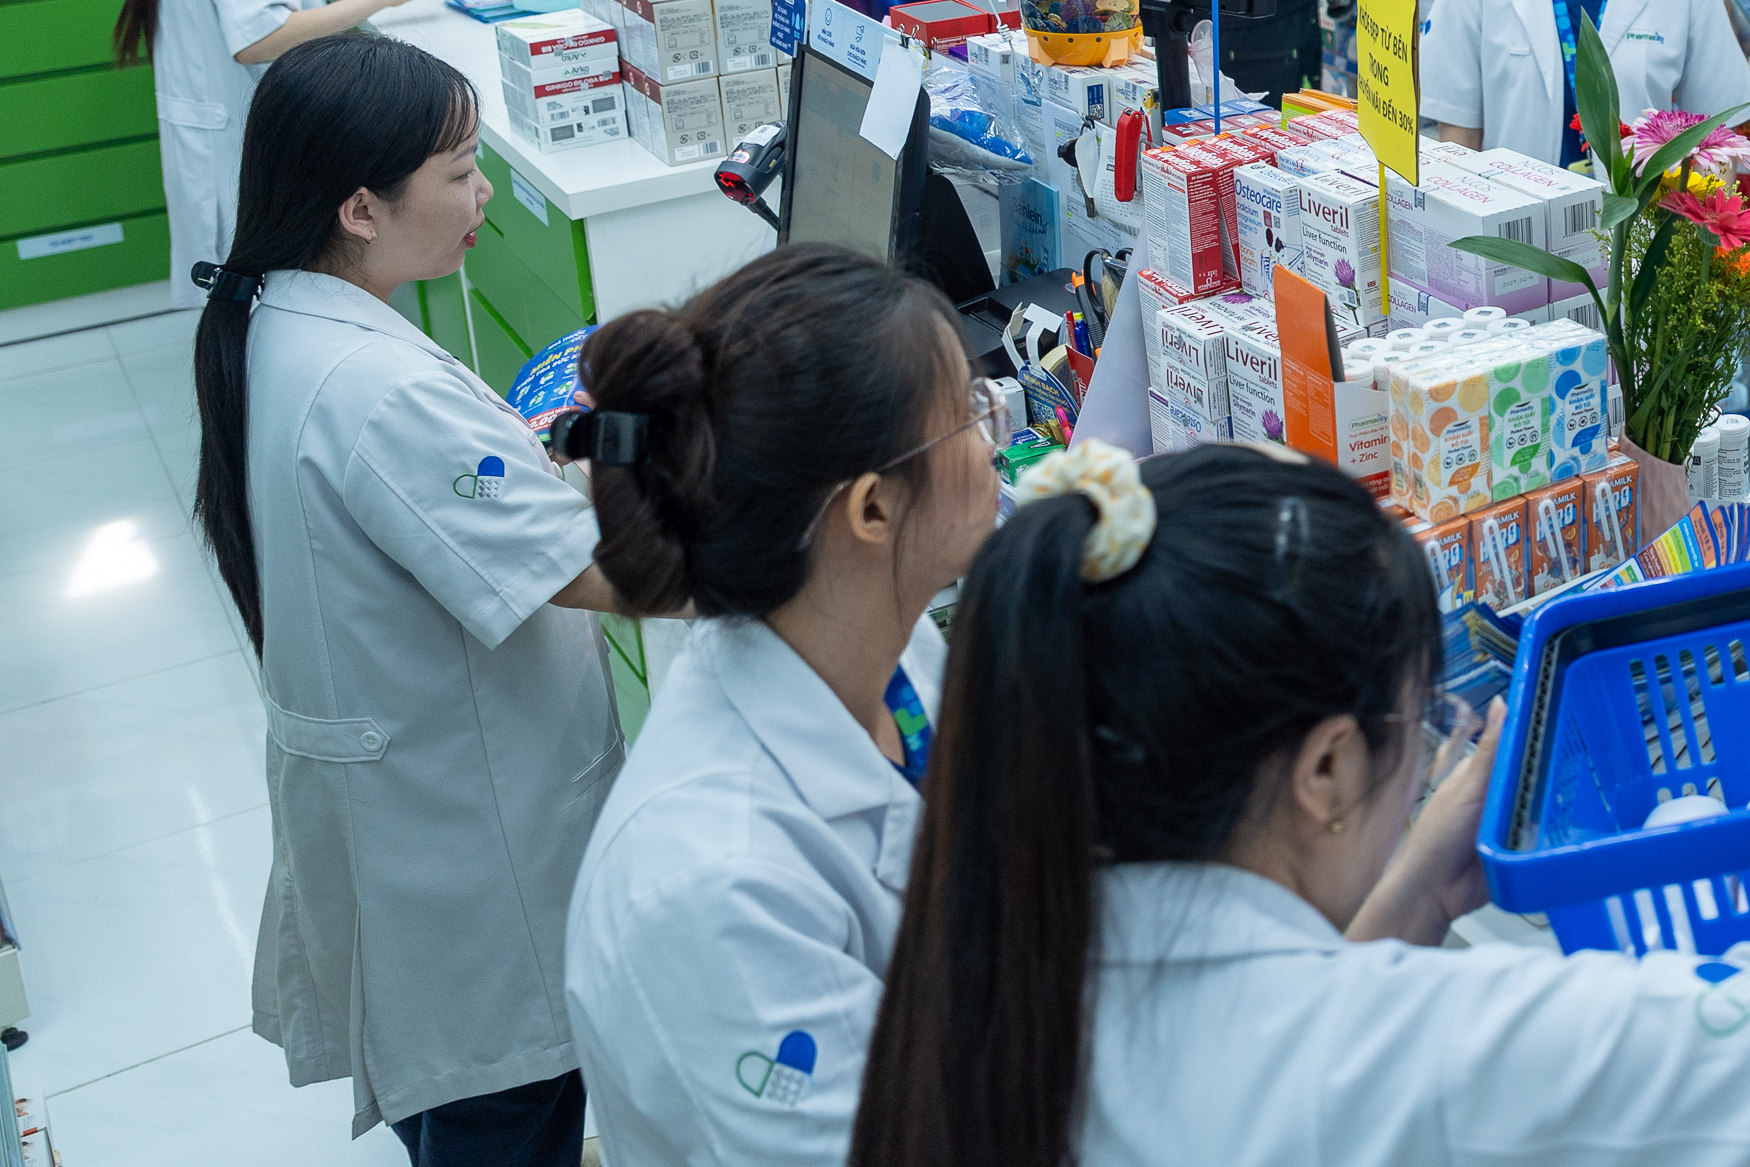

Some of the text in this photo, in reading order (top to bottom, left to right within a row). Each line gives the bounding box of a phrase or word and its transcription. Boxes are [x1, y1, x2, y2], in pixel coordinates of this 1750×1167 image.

[1381, 25, 1392, 51] TỪ
[1393, 33, 1408, 64] BÊN
[572, 66, 590, 74] Arko
[1368, 51, 1389, 87] TRONG
[1382, 98, 1398, 126] ĐẾN
[1399, 110, 1414, 136] 30%
[1489, 161, 1560, 188] COLLAGEN
[1234, 178, 1282, 214] Osteocare
[1385, 192, 1413, 211] COLLAGEN
[1426, 176, 1495, 204] COLLAGEN
[1012, 198, 1043, 226] Sanlein
[1237, 202, 1259, 218] calcium
[1299, 188, 1350, 230] Liveril
[1302, 226, 1348, 255] Liver function
[1330, 224, 1350, 238] tablets
[1388, 294, 1416, 314] COLLAGEN
[1162, 328, 1200, 367] Liveril
[1226, 336, 1278, 381] Liveril
[1166, 368, 1204, 409] Liveril
[1229, 373, 1276, 406] Liver function
[1258, 374, 1278, 389] tablets
[1351, 414, 1388, 429] Pharmacity
[1359, 451, 1378, 462] Zinc
